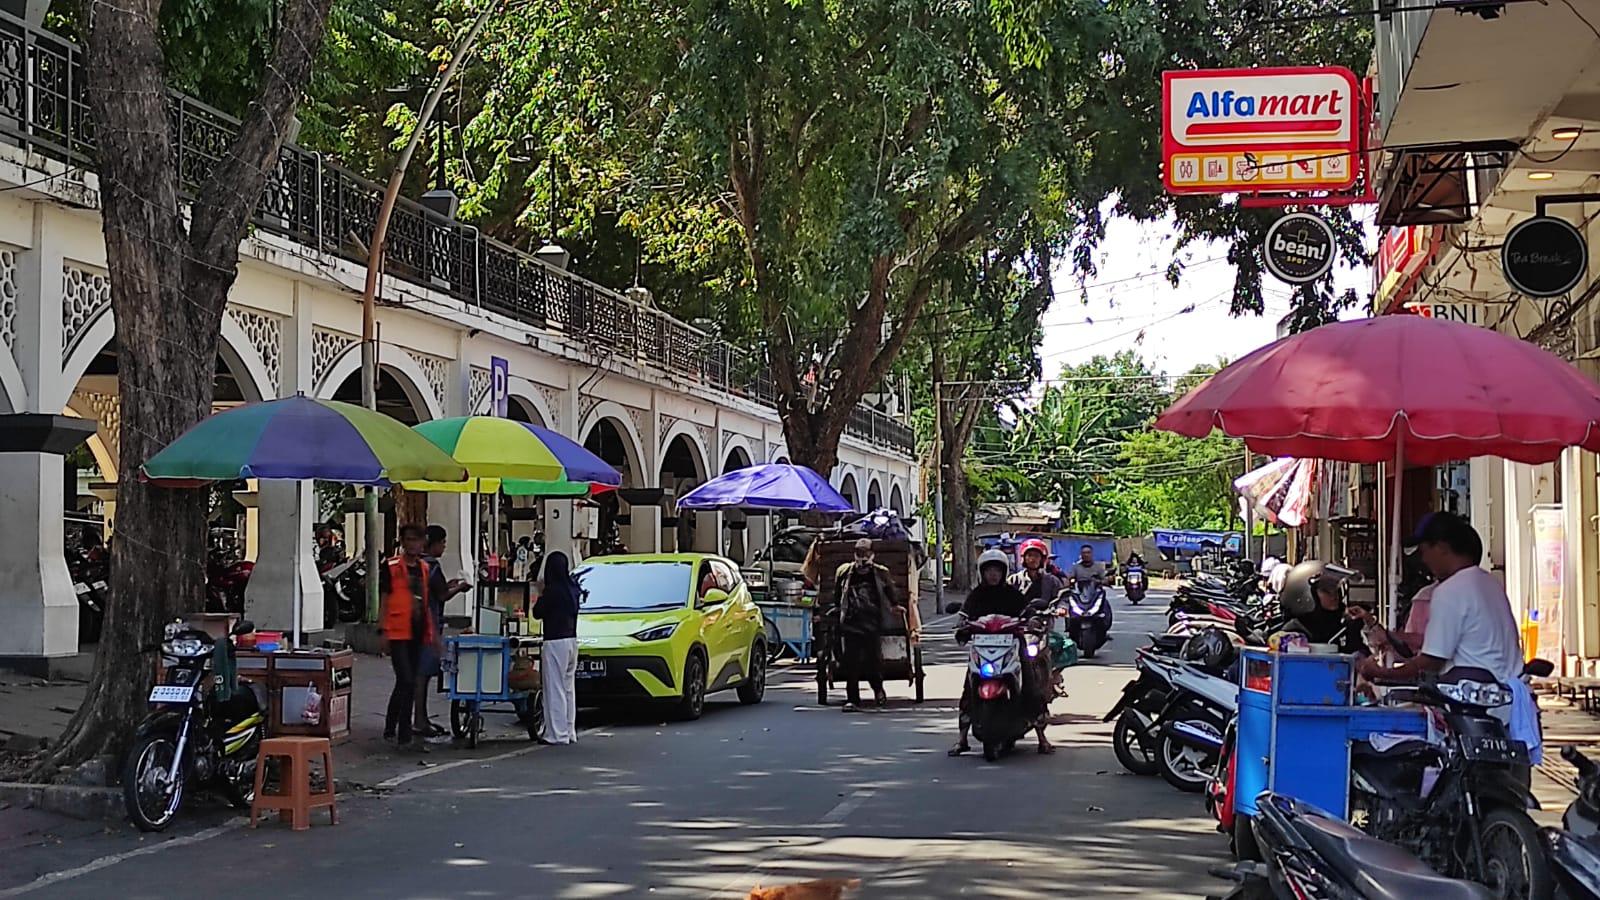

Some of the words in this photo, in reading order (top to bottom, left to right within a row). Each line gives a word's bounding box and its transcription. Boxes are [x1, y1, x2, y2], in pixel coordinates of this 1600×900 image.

[1186, 90, 1343, 118] Alfamart
[1273, 233, 1327, 261] bean!
[1286, 255, 1307, 265] SPOT
[1434, 304, 1477, 323] BNI
[495, 365, 505, 417] P
